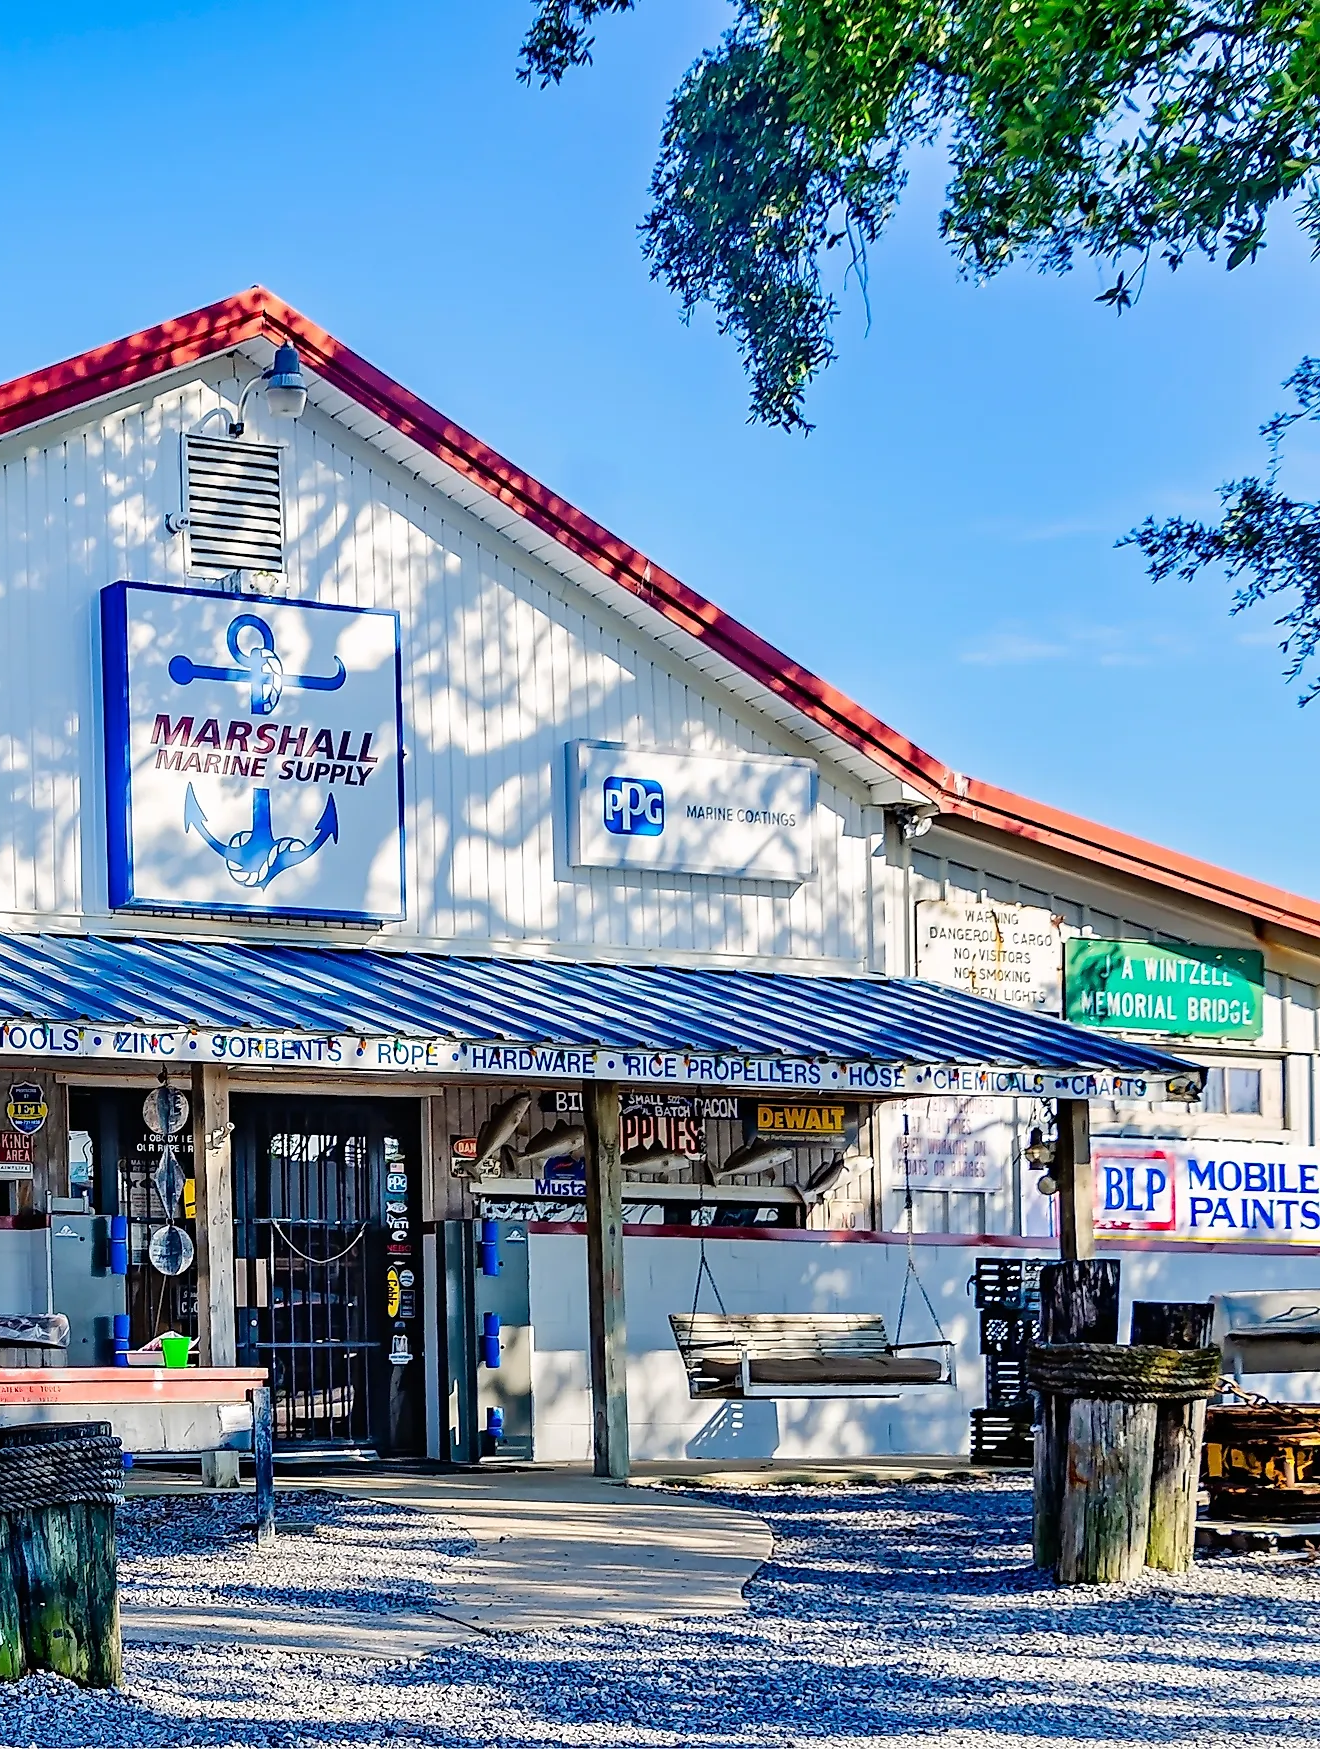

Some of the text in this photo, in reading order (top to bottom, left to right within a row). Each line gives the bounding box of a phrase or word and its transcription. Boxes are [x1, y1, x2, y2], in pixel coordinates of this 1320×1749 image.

[150, 713, 379, 765] MARSHALL
[155, 748, 374, 787] MARINE SUPPLY
[605, 781, 797, 831] PPG MARINE COATINGS
[965, 909, 1019, 925] WARNING
[929, 926, 1053, 947] DANGEROUS CARGO
[953, 947, 1031, 965] NO VISITORS
[953, 966, 1031, 983] NO SMOKING
[1121, 961, 1134, 981] A
[1143, 959, 1234, 988] WINTZELL
[1004, 988, 1046, 1004] LIGHTS
[1081, 990, 1254, 1026] MEMORIAL BRIDGE
[117, 1031, 176, 1055] ZINC
[211, 1035, 342, 1063] SORBENTS
[377, 1042, 439, 1066] ROPE
[472, 1047, 595, 1075] HARDWARE
[628, 1055, 677, 1078] RICE
[687, 1056, 822, 1085] PROPELLERS
[848, 1064, 906, 1088] HOSE
[933, 1070, 1045, 1095] CHEMICALS
[654, 1105, 691, 1118] BATCH
[619, 1115, 701, 1155] PPLIES
[5, 1149, 31, 1162] AREA
[973, 1140, 987, 1157] ON
[896, 1159, 929, 1176] FOATS
[933, 1159, 945, 1177] OR
[1187, 1159, 1320, 1194] MOBILE
[387, 1175, 407, 1190] PPG
[535, 1179, 587, 1197] Musta
[1103, 1166, 1166, 1212] BLP
[386, 1213, 410, 1230] YETI
[1189, 1197, 1320, 1231] PAINTS
